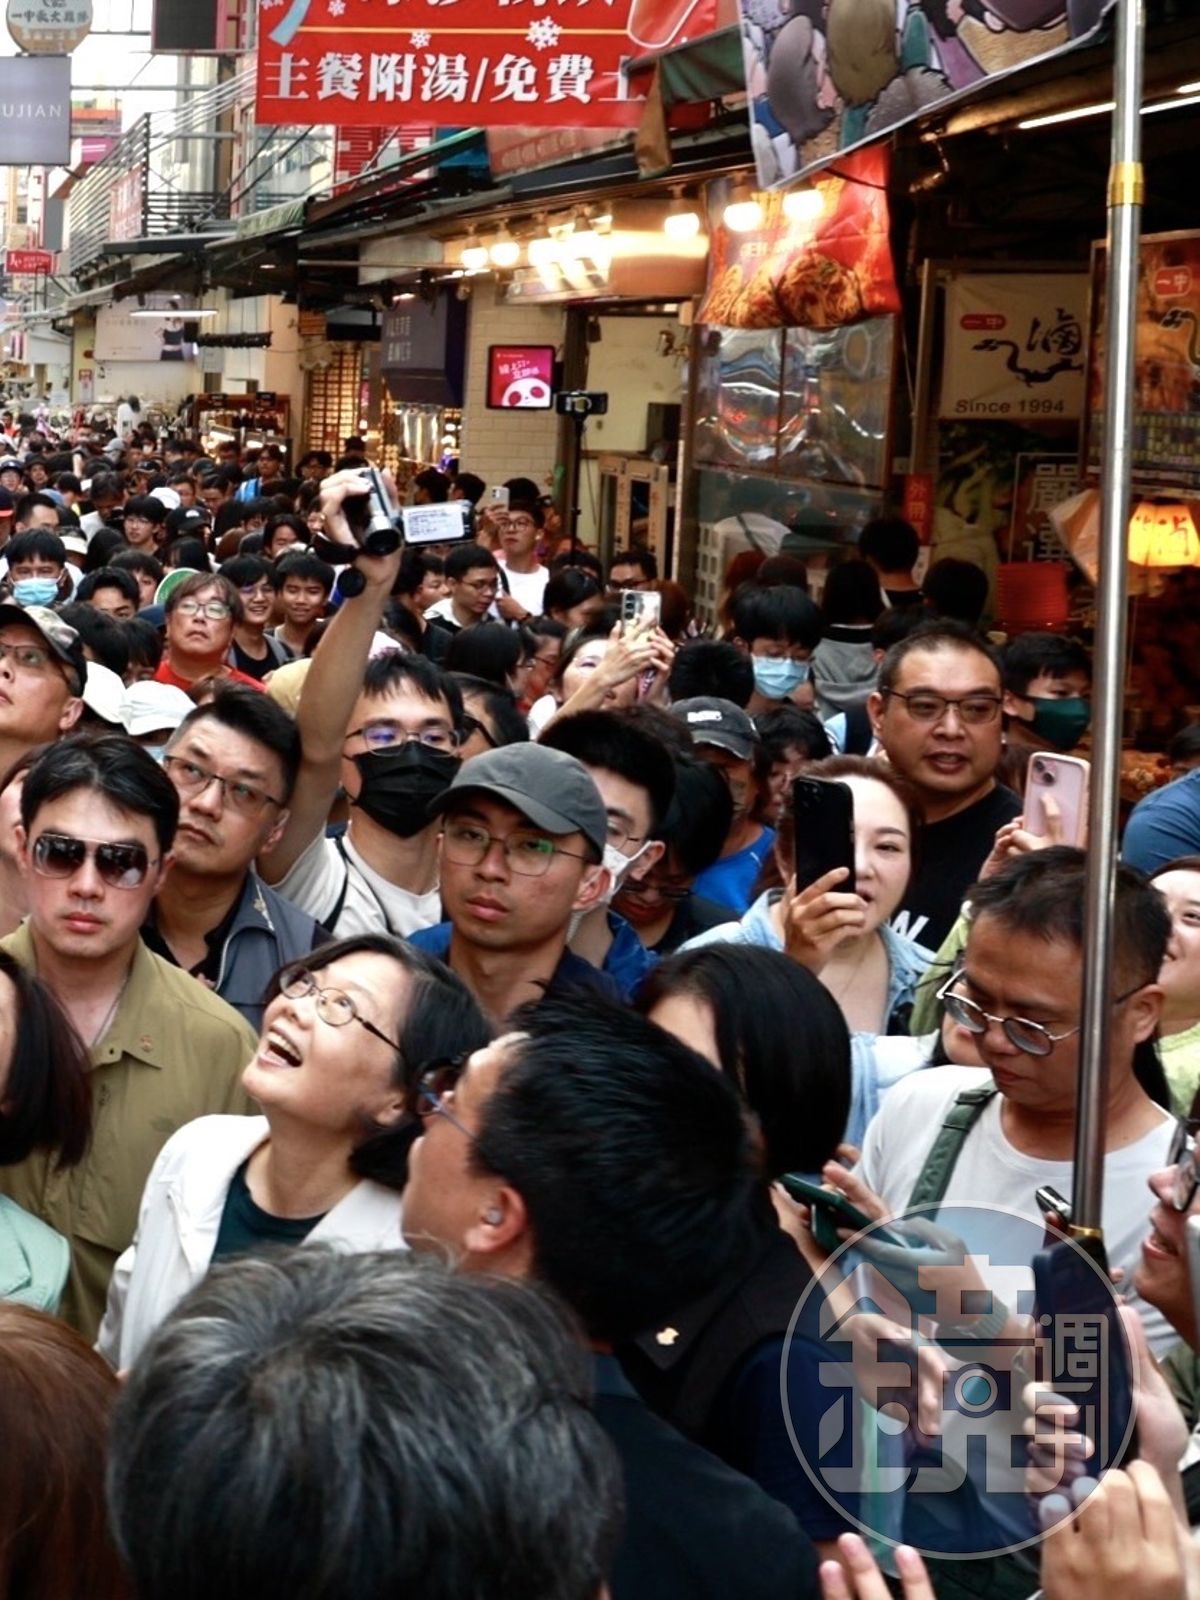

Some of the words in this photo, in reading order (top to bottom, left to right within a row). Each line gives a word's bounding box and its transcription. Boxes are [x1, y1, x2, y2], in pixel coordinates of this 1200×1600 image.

[1157, 273, 1188, 293] 一中
[955, 400, 1011, 414] Since
[1019, 400, 1065, 414] 1994
